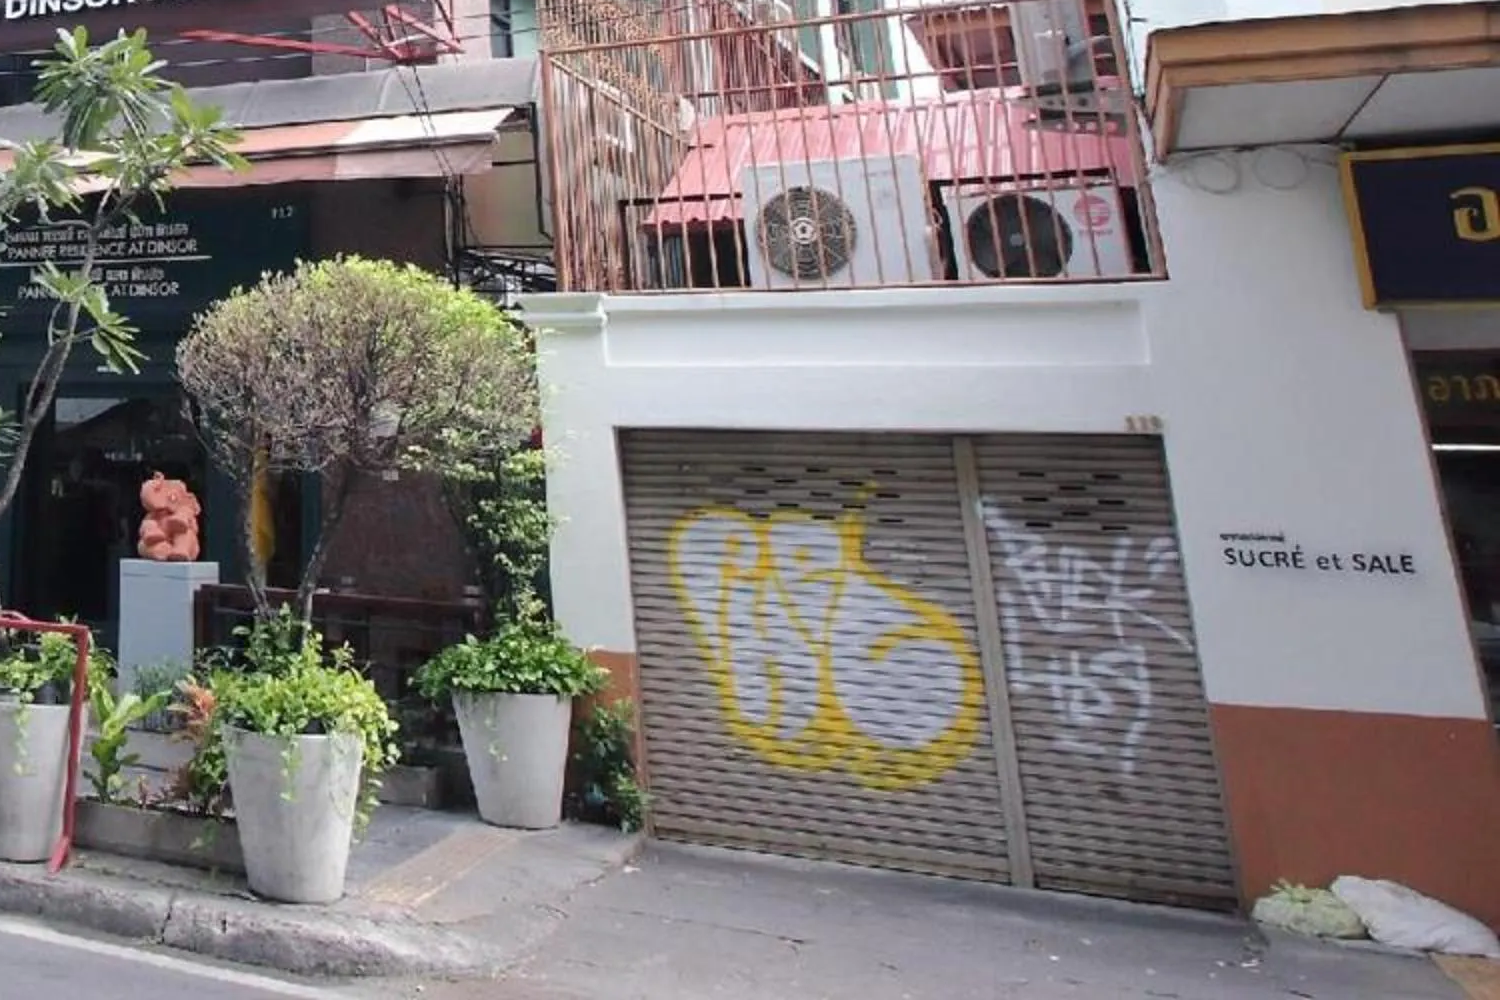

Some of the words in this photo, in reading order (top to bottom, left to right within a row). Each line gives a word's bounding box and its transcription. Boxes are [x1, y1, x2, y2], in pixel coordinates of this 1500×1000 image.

[1223, 545, 1306, 570] SUCRÉ
[1316, 554, 1344, 571] et
[1351, 553, 1417, 575] SALE
